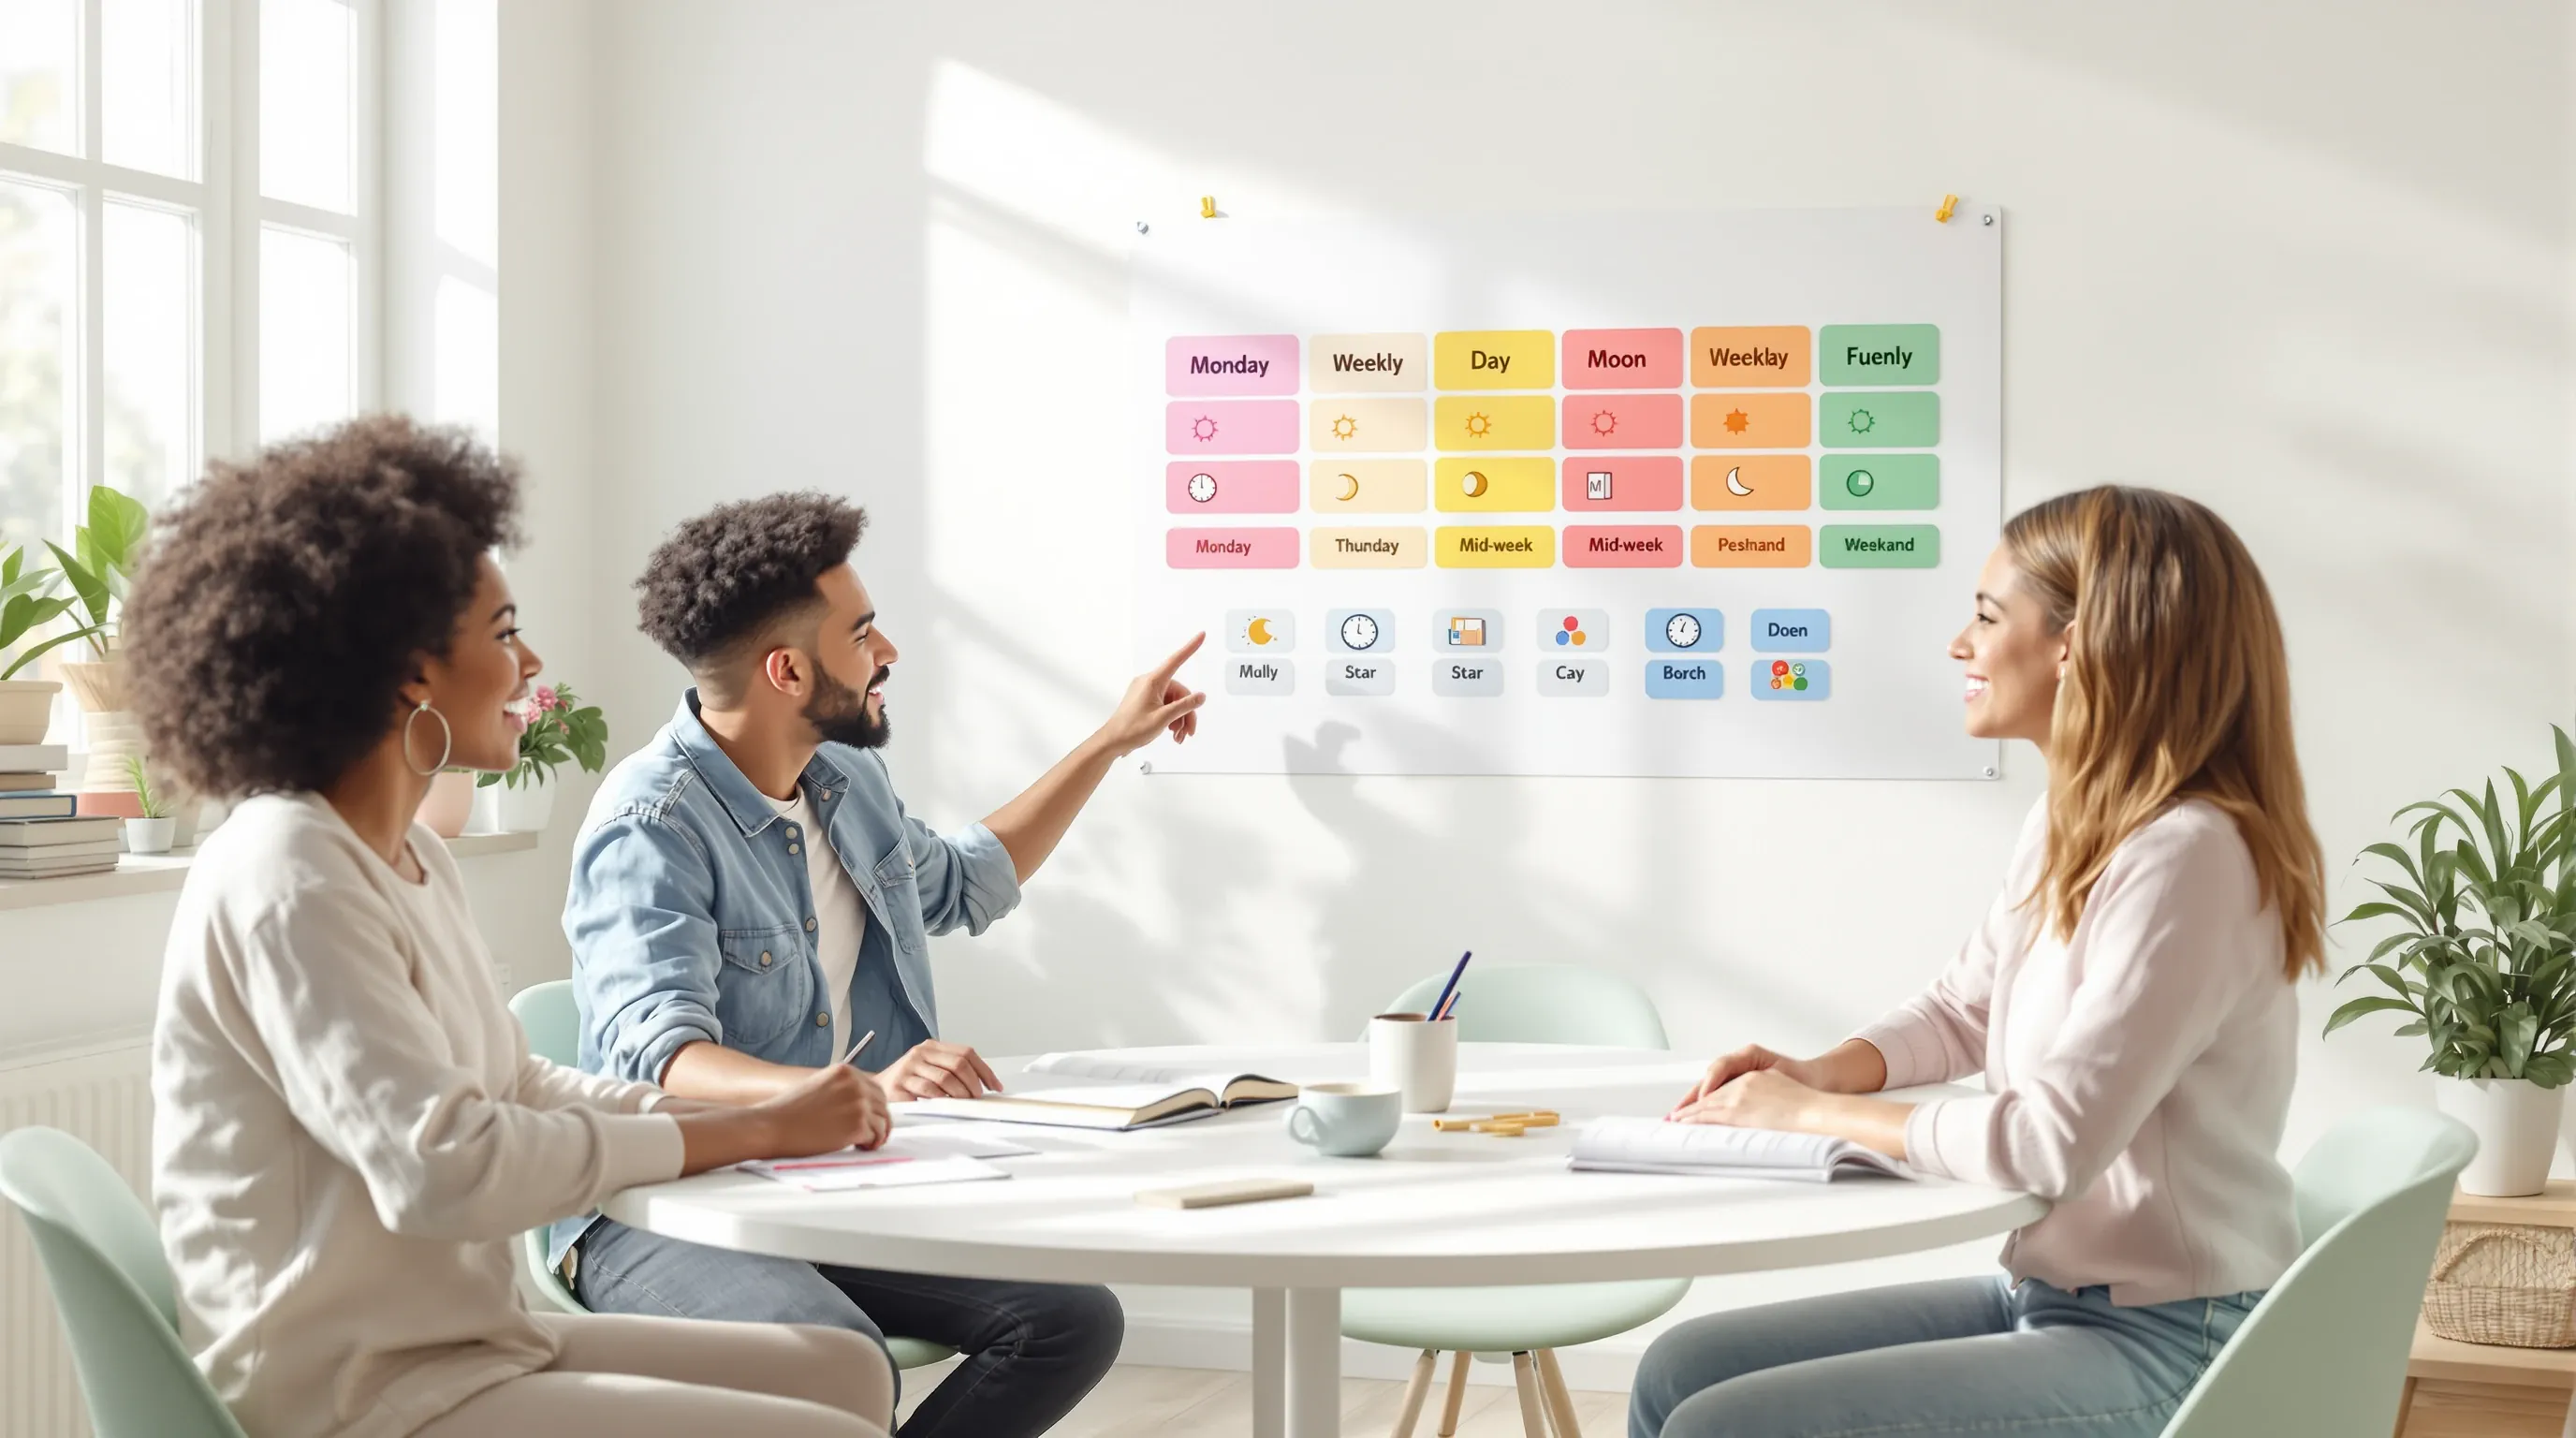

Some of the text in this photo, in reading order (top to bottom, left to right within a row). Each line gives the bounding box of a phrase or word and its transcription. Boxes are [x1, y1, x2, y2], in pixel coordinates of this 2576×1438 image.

[1190, 354, 1270, 378] Monday
[1332, 352, 1404, 376] Weekly
[1471, 349, 1511, 374] Day
[1588, 349, 1647, 369] Moon
[1709, 346, 1789, 371] Weeklay
[1847, 345, 1913, 370] Fuenly
[1589, 479, 1602, 492] M
[1195, 538, 1251, 557] Monday
[1459, 536, 1533, 552] Mid-week
[1588, 536, 1663, 552] Mid-week
[1844, 536, 1915, 552] Weekand
[1768, 622, 1808, 638] Doen
[1344, 665, 1377, 680] Star
[1451, 665, 1484, 680] Star
[1556, 665, 1586, 683] Cay
[1663, 665, 1706, 681] Borch
